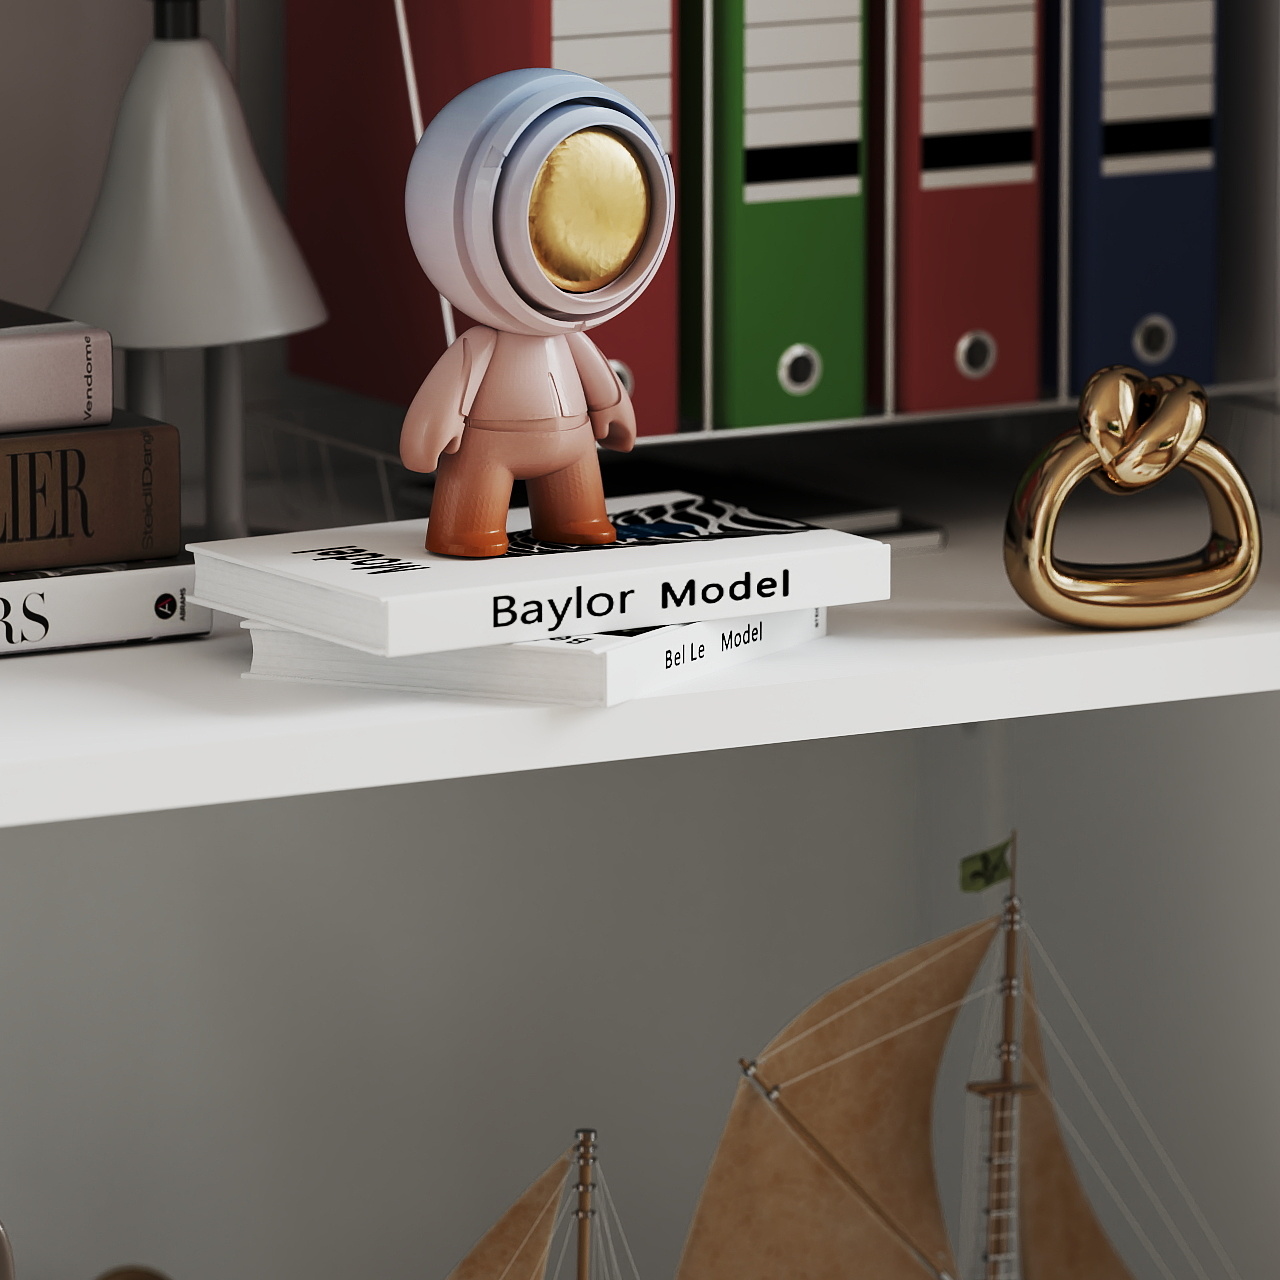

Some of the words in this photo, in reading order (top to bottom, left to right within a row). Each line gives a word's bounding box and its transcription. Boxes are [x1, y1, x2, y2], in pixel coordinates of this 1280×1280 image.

[83, 336, 93, 420] Vendome
[492, 585, 634, 630] Baylor
[660, 569, 790, 609] Model
[665, 643, 685, 669] Bel
[690, 641, 706, 663] Le
[720, 621, 763, 653] Model
